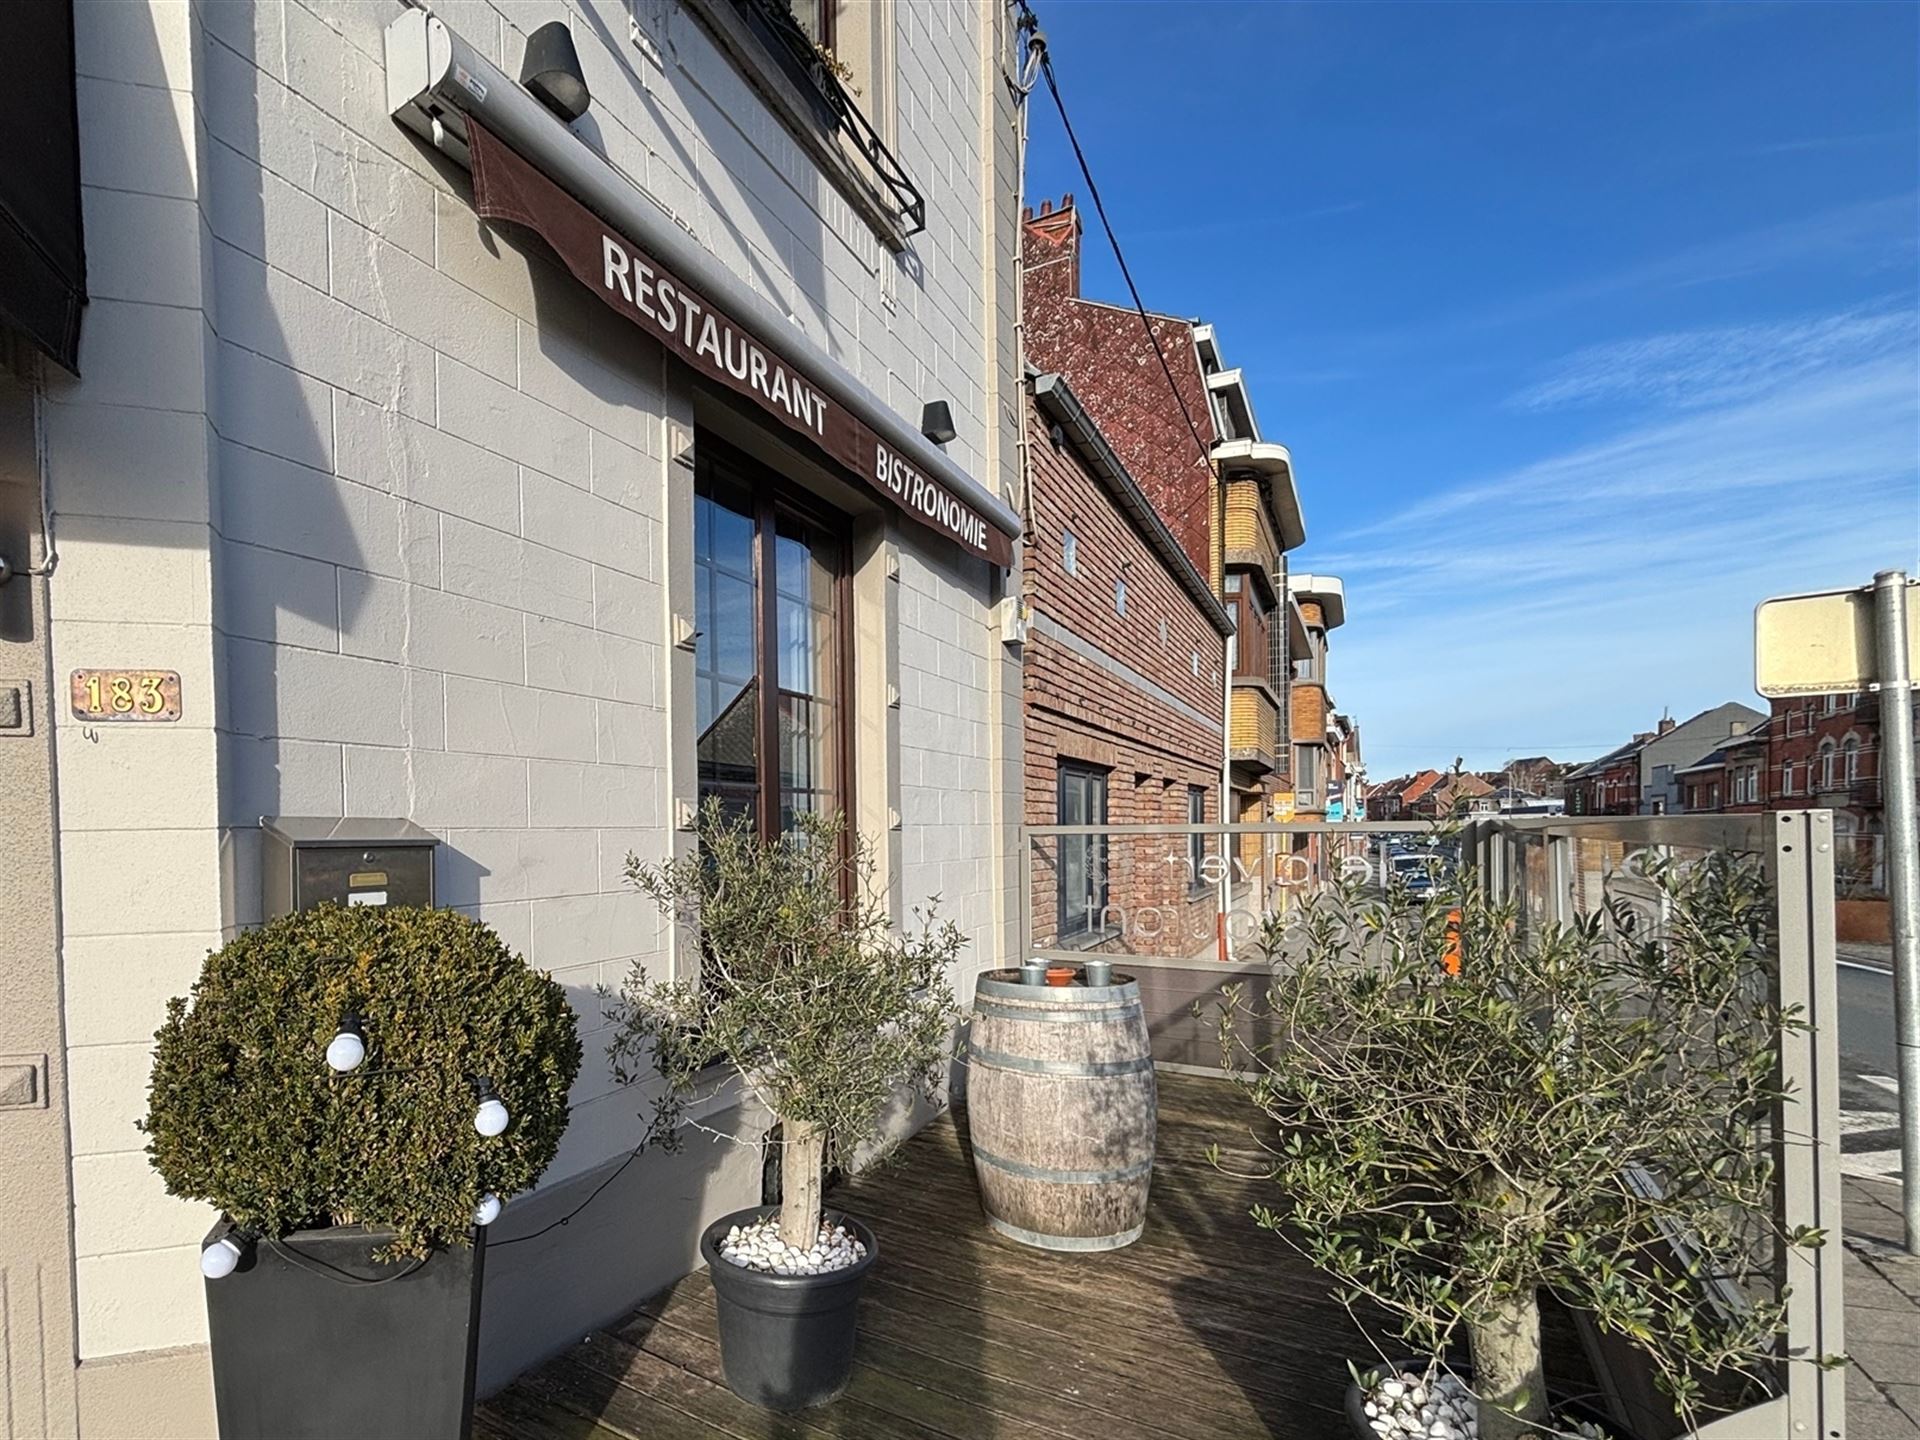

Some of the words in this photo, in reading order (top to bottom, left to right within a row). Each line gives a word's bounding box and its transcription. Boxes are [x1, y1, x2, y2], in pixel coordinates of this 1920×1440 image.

[602, 235, 827, 435] RESTAURANT
[876, 443, 987, 551] BISTRONOMIE
[85, 676, 165, 714] 183
